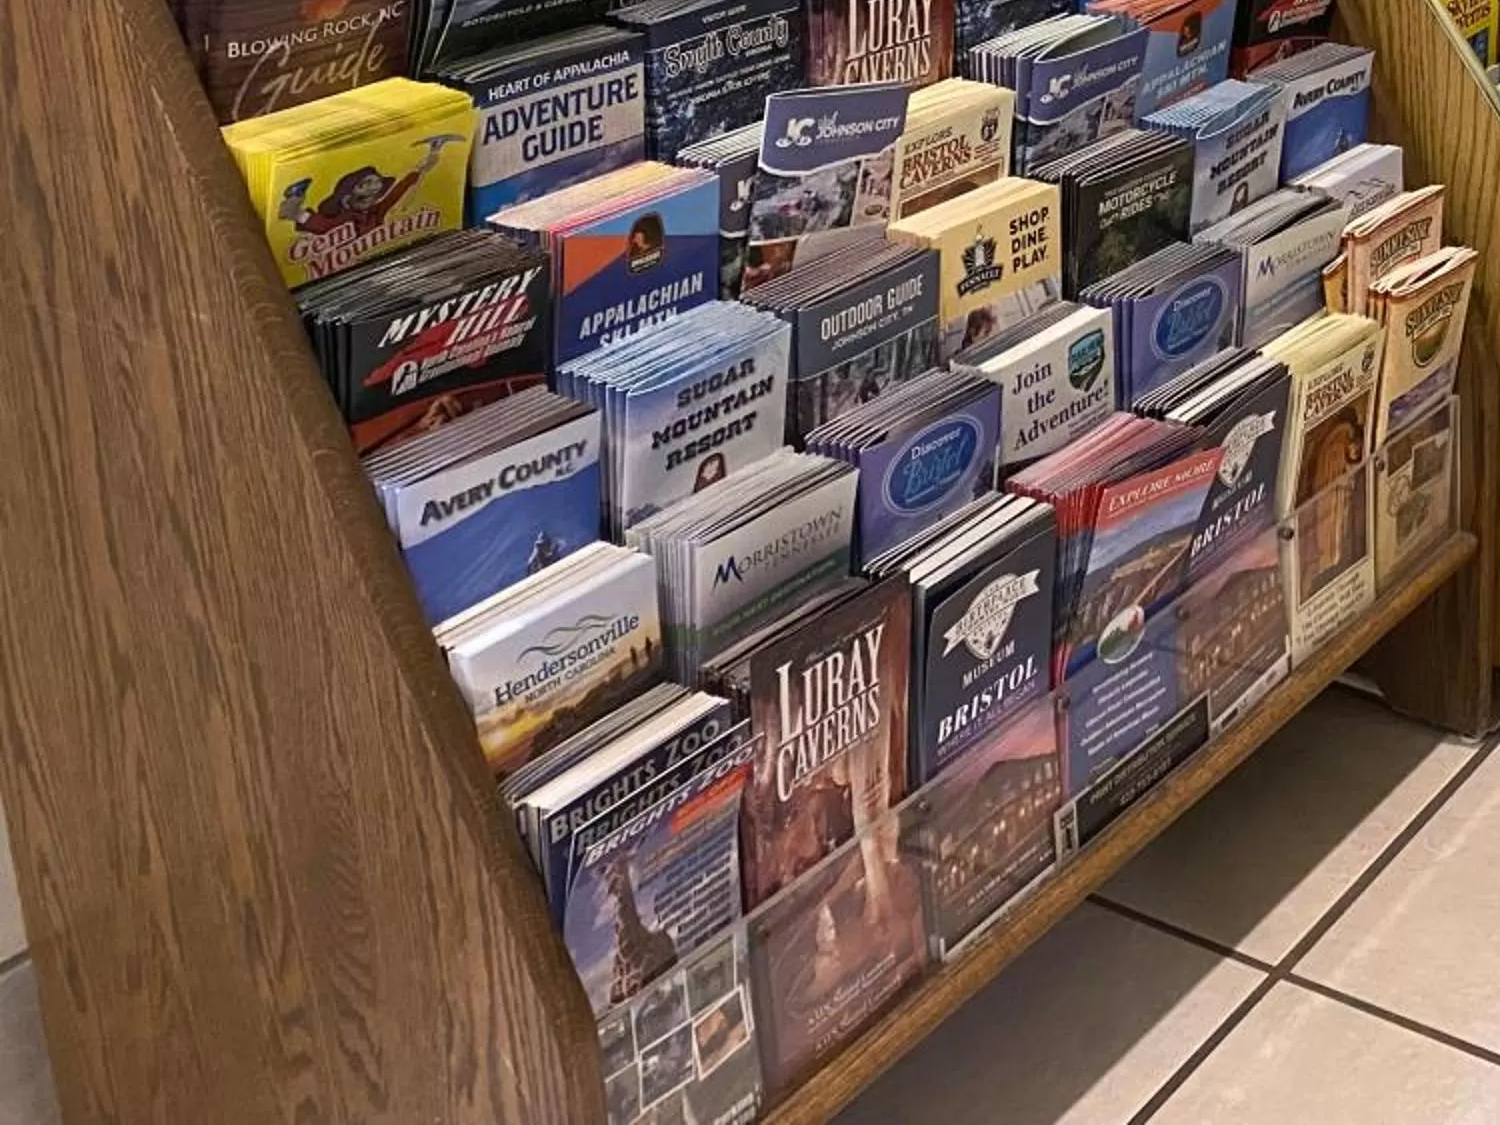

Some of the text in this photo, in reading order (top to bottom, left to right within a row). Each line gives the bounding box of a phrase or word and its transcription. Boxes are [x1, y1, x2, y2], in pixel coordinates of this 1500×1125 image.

[227, 0, 405, 59] BLOWING NC
[663, 27, 726, 77] Smyth
[725, 15, 789, 54] County
[232, 19, 385, 121] Guide
[488, 50, 630, 101] HEART OF APPALACHIA
[1117, 55, 1140, 71] CITY
[1326, 71, 1367, 95] COUNTY
[483, 73, 639, 145] ADVENTURE
[815, 116, 900, 140] JOHNSON CITY
[522, 115, 603, 162] GUIDE
[900, 143, 971, 190] CAVERNS
[903, 134, 966, 171] BRISTOL
[1209, 124, 1280, 179] MOUNTAIN
[1099, 169, 1178, 216] MOTORCYCLE
[1217, 150, 1268, 195] RESORT
[1121, 196, 1153, 220] RIDES
[289, 222, 357, 263] Gem
[308, 205, 441, 281] Mountain
[377, 265, 542, 349] MYSTERY
[443, 294, 528, 348] HILL
[579, 271, 704, 340] APPALACHIAN
[820, 295, 884, 341] OUTDOOR
[887, 273, 924, 311] GUIDE
[832, 312, 899, 352] JOHNSON CITY
[676, 357, 756, 408] SUGAR
[1012, 362, 1052, 396] Join
[1027, 387, 1057, 415] the
[650, 375, 776, 451] MOUNTAIN
[664, 411, 758, 471] RESORT
[1013, 379, 1110, 451] Adventure!
[911, 426, 963, 460] Discover
[420, 439, 587, 527] AVERY COUNTY
[713, 506, 842, 589] MORRISTOWN
[1190, 483, 1268, 557] BRISTOL
[494, 613, 640, 707] Hendersonville
[525, 648, 616, 704] NORTH CAROLINA
[776, 624, 884, 746] LURAY
[962, 639, 1016, 690] MUSEUM
[937, 655, 1038, 745] BRISTOL
[777, 685, 882, 803] CAVERNS
[550, 717, 720, 844] BRIGHTS ZOO
[585, 747, 754, 867] BRIGHTS ZOO
